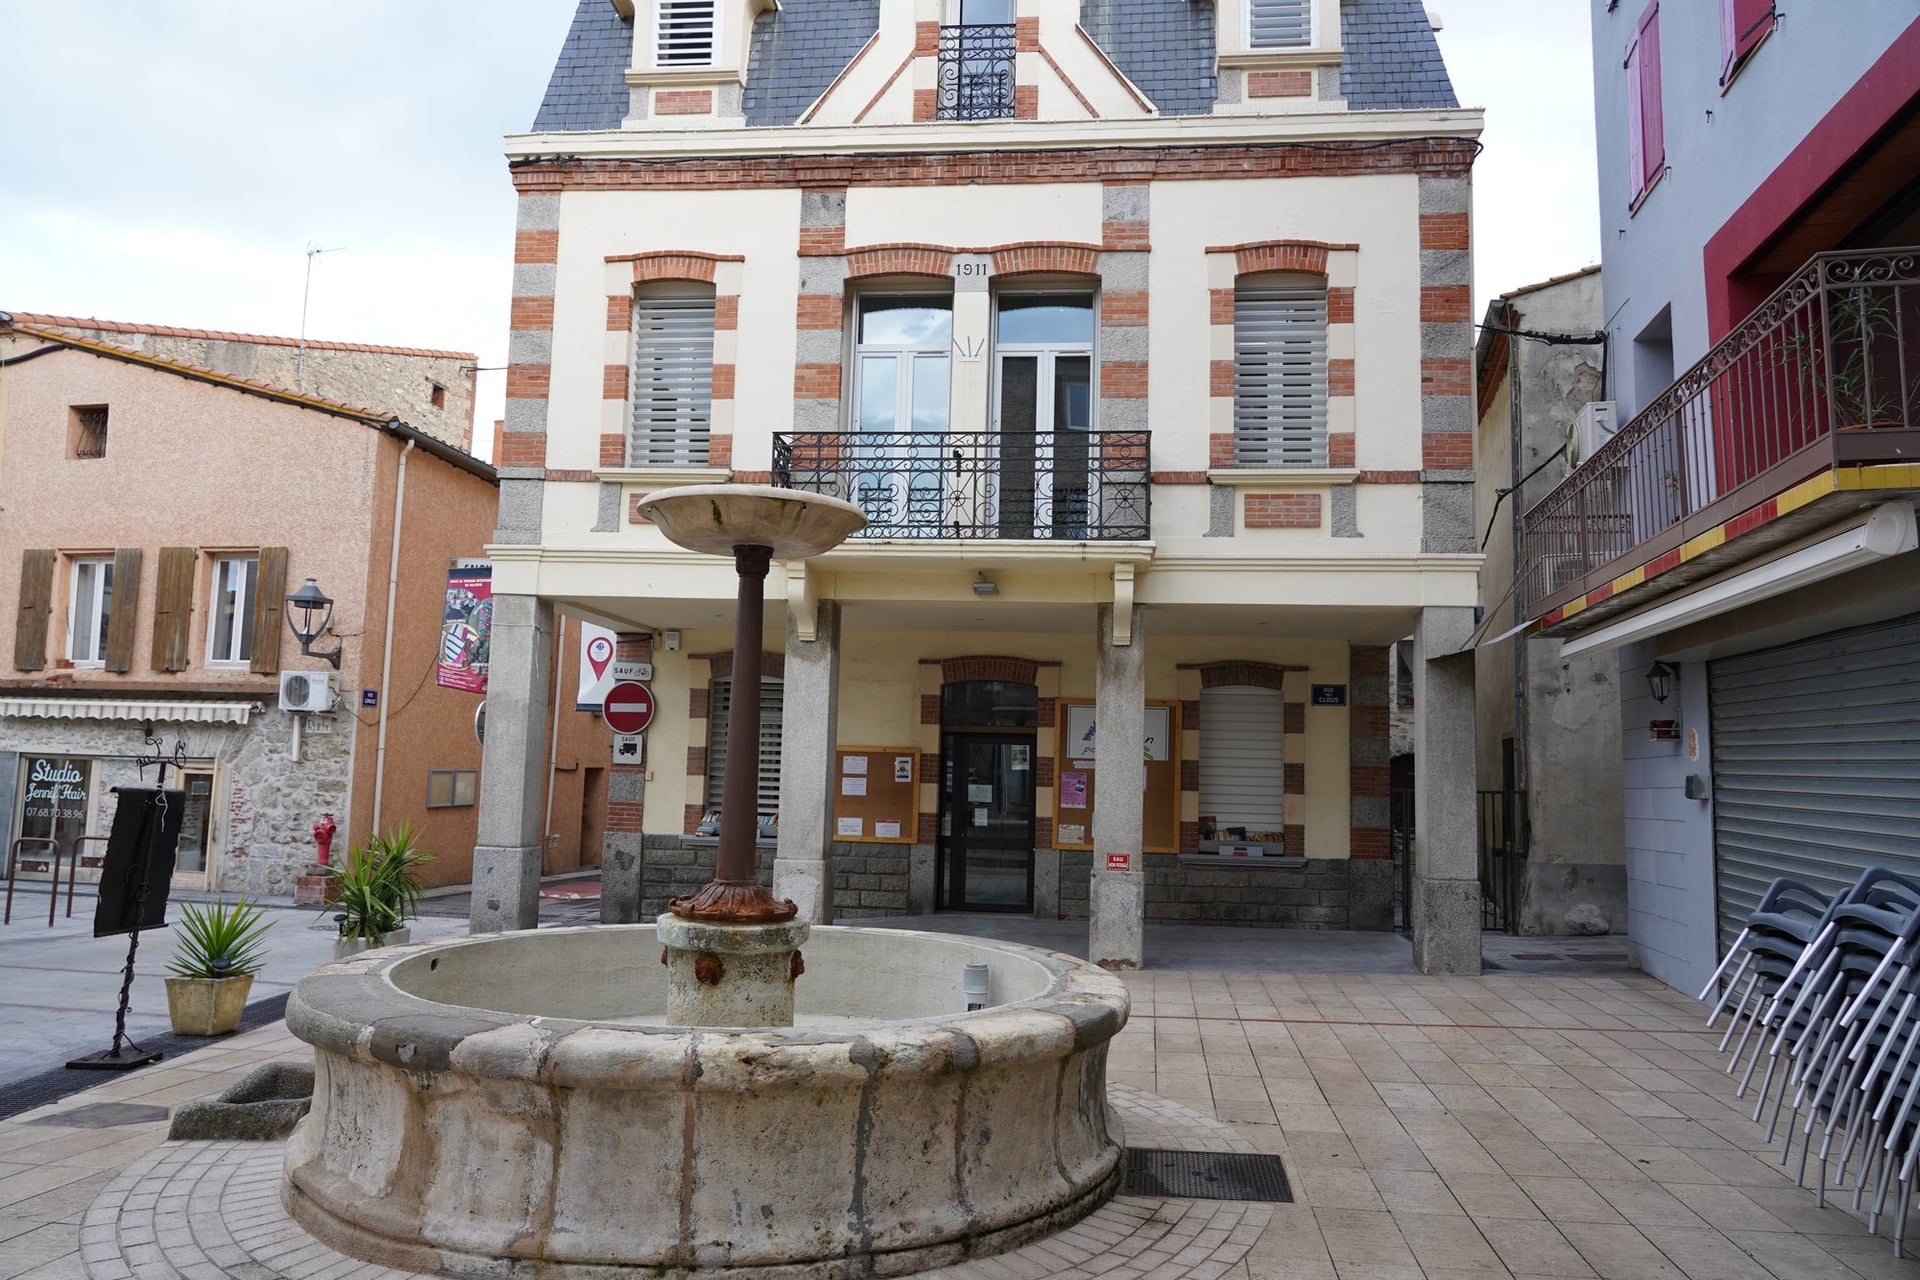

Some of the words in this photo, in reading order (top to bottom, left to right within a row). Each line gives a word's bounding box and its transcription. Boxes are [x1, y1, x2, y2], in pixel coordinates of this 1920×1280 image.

[956, 263, 987, 276] 1911
[31, 759, 83, 782] Studio
[26, 807, 83, 819] 07.68.70.38.96
